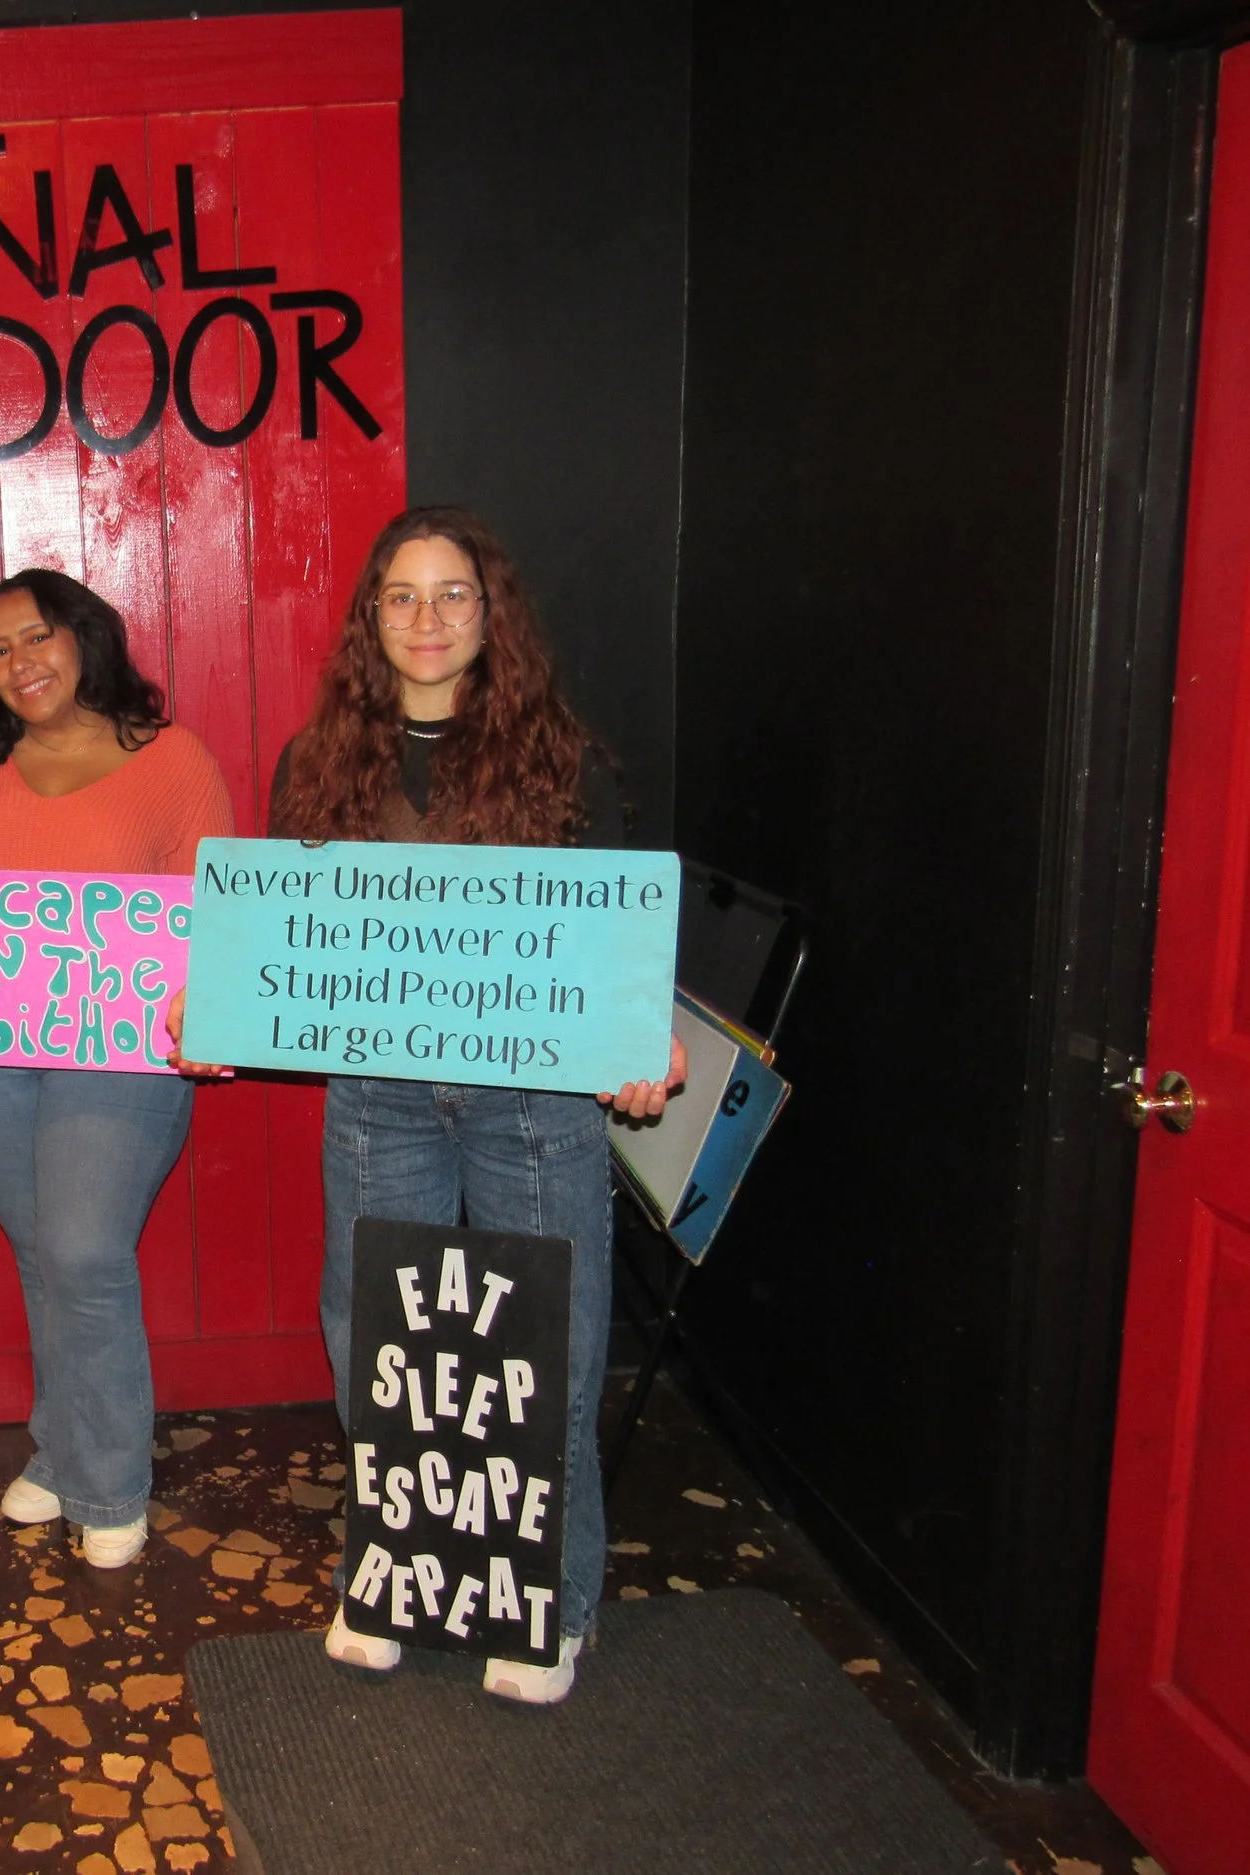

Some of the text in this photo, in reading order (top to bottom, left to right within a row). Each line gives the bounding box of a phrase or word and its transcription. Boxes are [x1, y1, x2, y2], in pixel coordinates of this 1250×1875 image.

[203, 862, 664, 911] Never Underestimate
[285, 914, 565, 959] the Power of
[258, 963, 585, 1018] Stupid People in
[272, 1015, 560, 1075] Large Groups
[395, 1247, 513, 1336] EAT
[371, 1343, 534, 1440] SLEEP
[353, 1442, 550, 1543] ESCAPE
[348, 1542, 553, 1649] REPEAT
